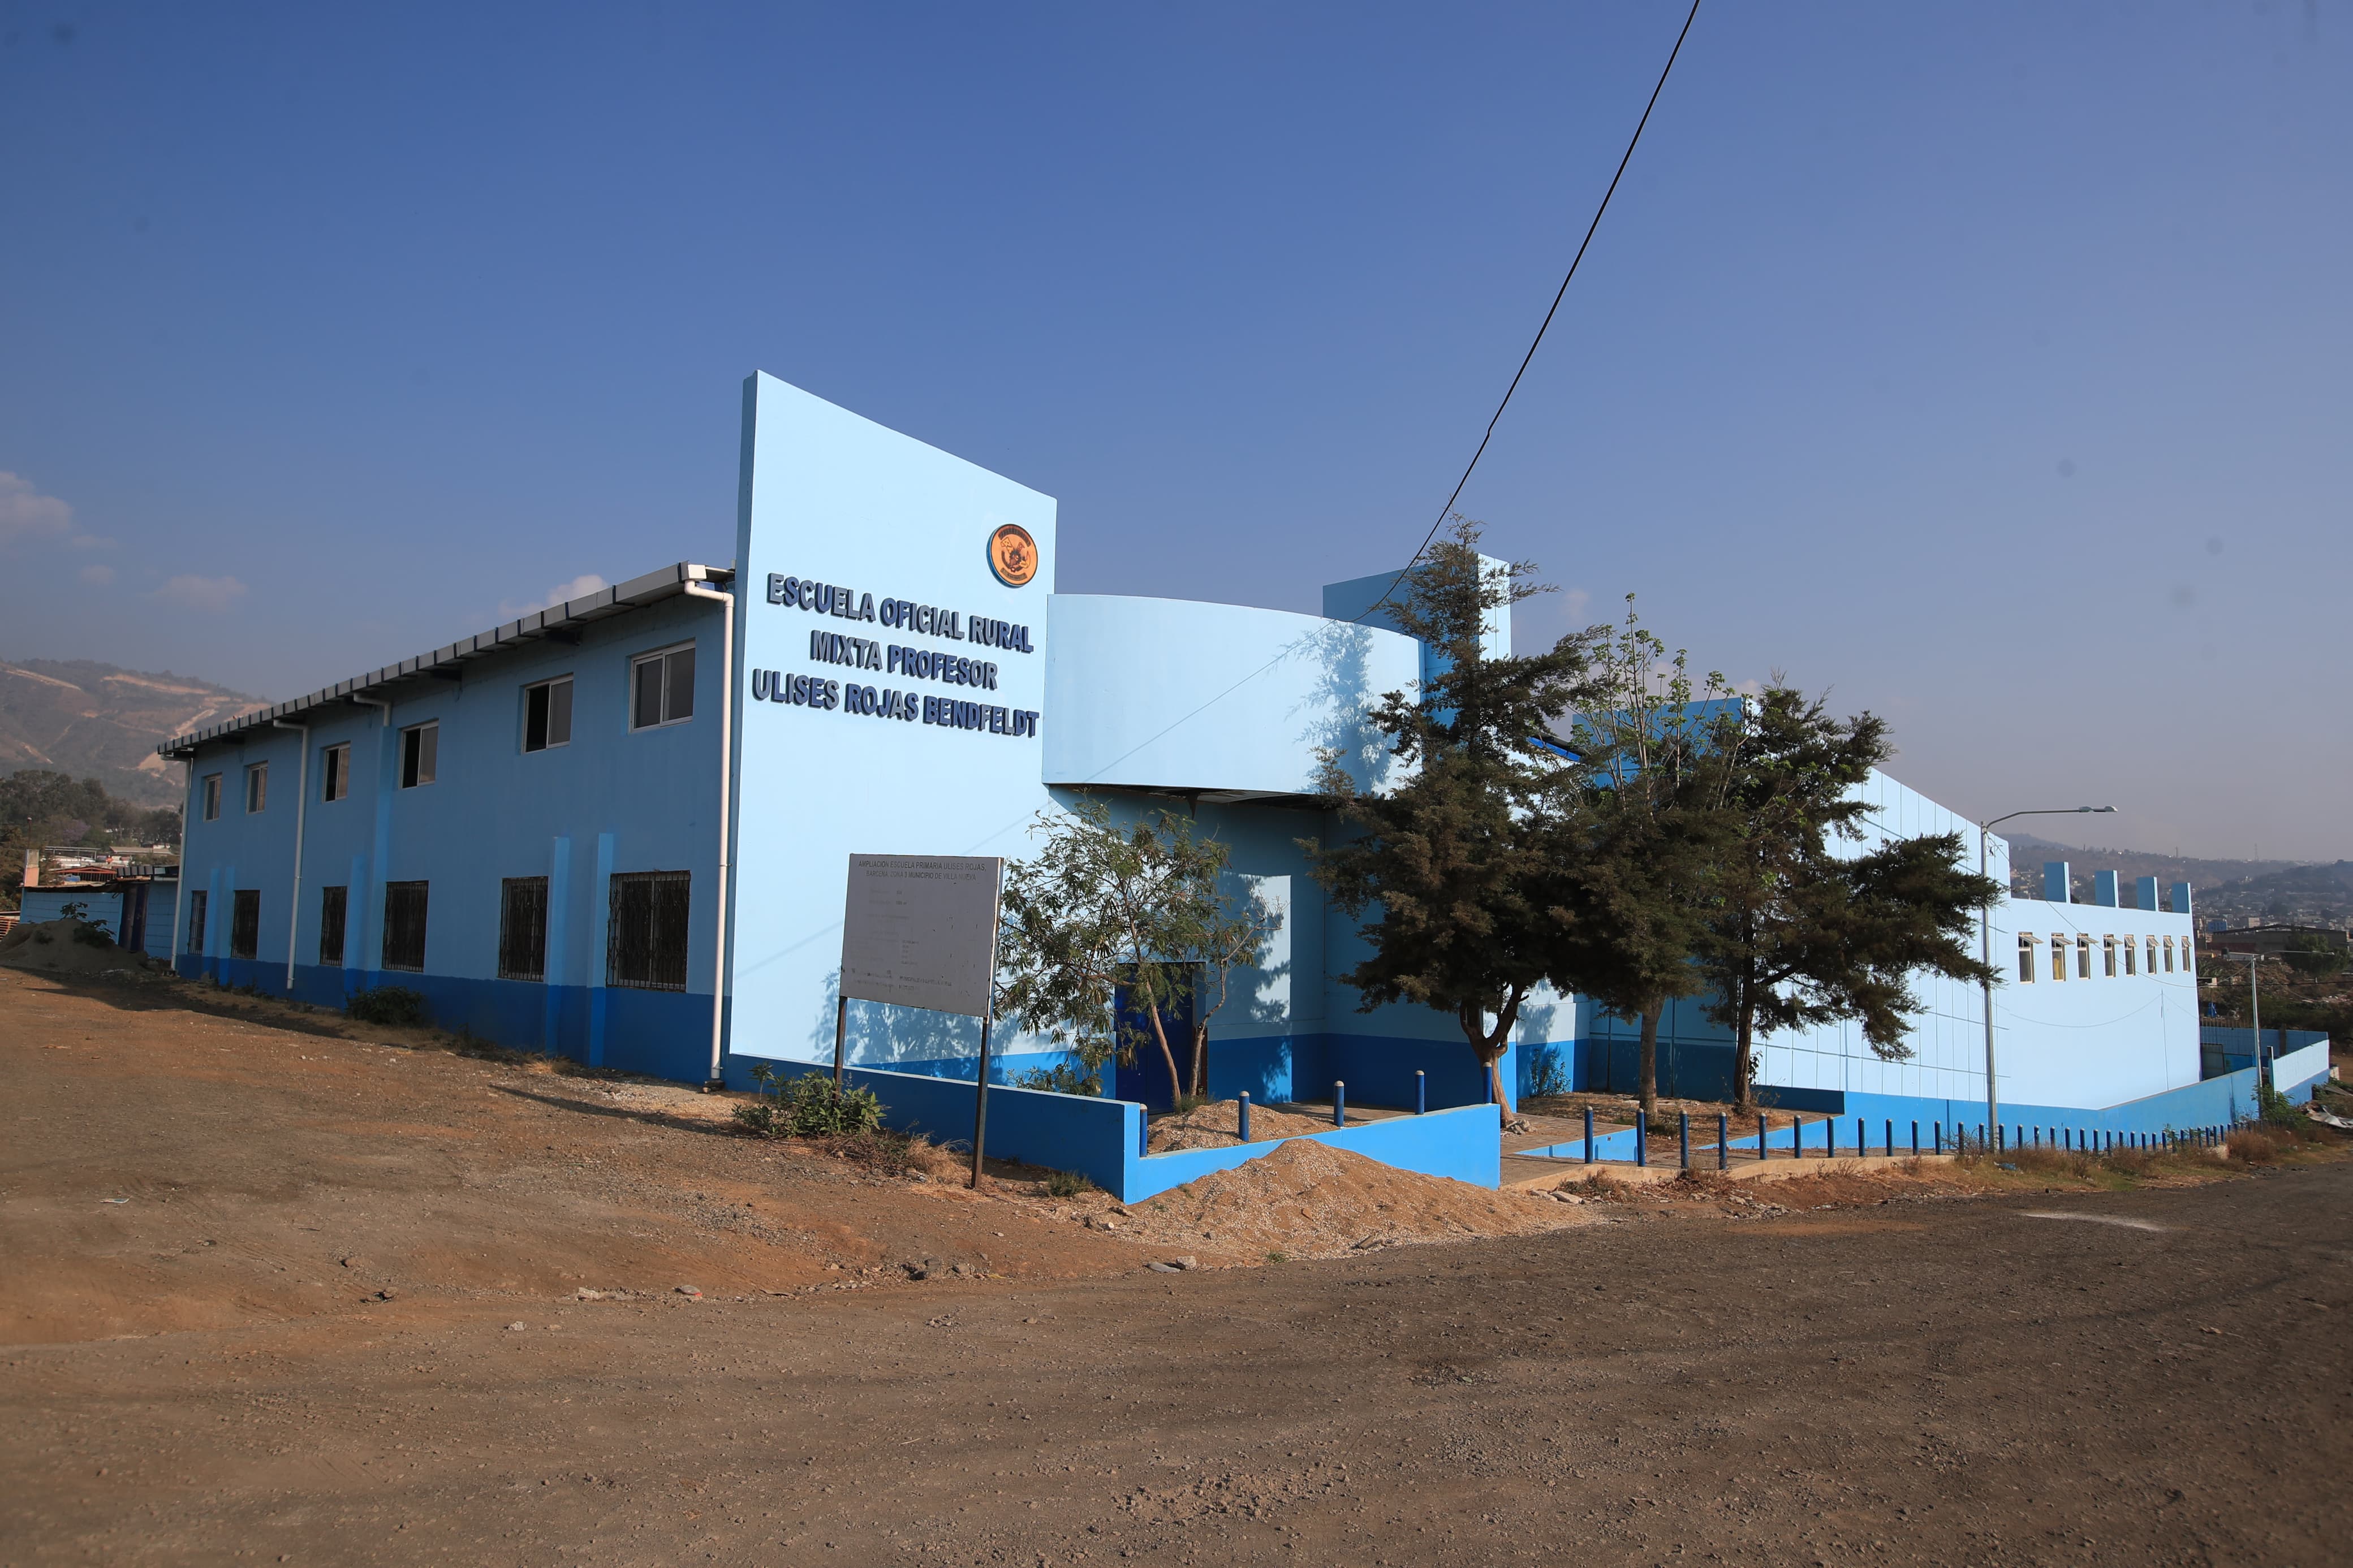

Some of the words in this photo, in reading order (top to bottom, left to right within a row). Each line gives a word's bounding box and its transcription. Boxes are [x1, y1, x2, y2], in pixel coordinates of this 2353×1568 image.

[766, 573, 876, 623] ESCUELA
[880, 598, 964, 640] OFICIAL
[969, 615, 1034, 654] RURAL
[810, 630, 882, 671] MIXTA
[887, 645, 998, 690] PROFESOR
[752, 668, 839, 711] ULISES
[844, 684, 919, 723] ROJAS
[923, 696, 1039, 738] BENDFELDT
[916, 861, 942, 870] PRIMARIA
[943, 862, 964, 870] ULISES
[965, 863, 986, 871] ROJAS,
